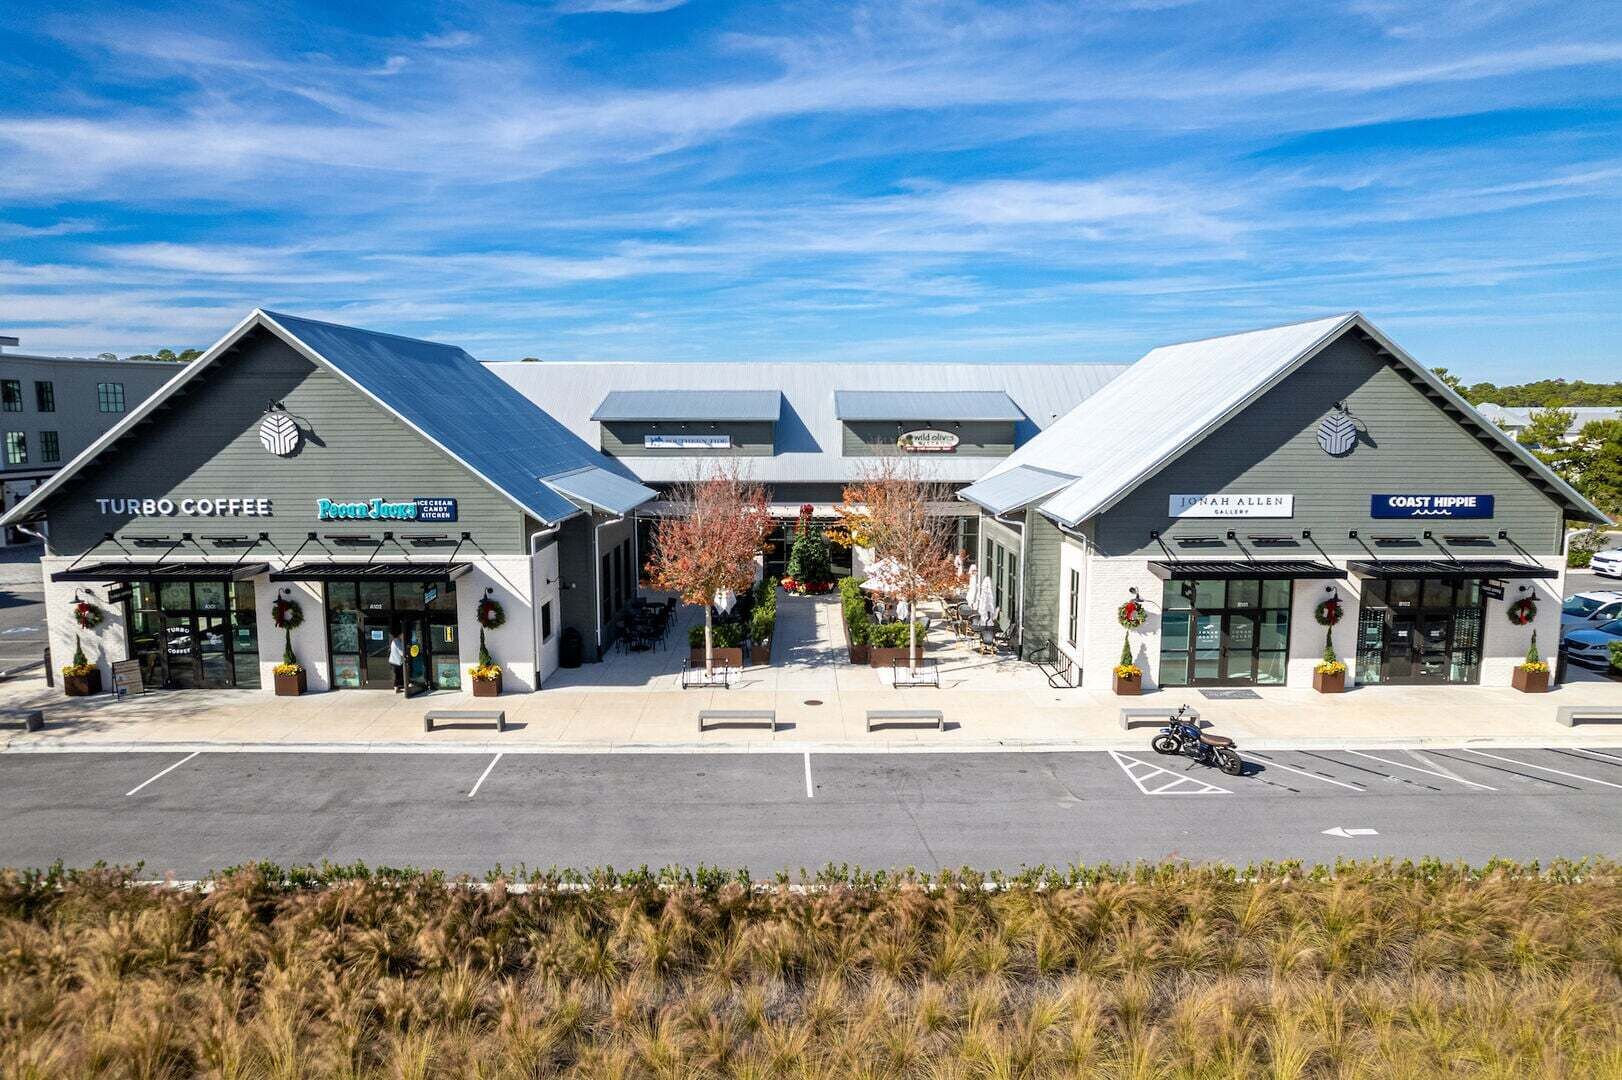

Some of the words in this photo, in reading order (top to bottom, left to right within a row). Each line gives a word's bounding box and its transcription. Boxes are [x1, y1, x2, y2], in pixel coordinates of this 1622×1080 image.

[914, 433, 930, 441] wild
[95, 498, 175, 515] TURBO
[180, 498, 270, 515] COFFEE
[1180, 497, 1230, 507] JONAH
[1236, 497, 1284, 506] ALLEN
[1388, 496, 1432, 508] COAST
[1433, 496, 1477, 508] HIPPIE
[317, 498, 369, 519] Pecan
